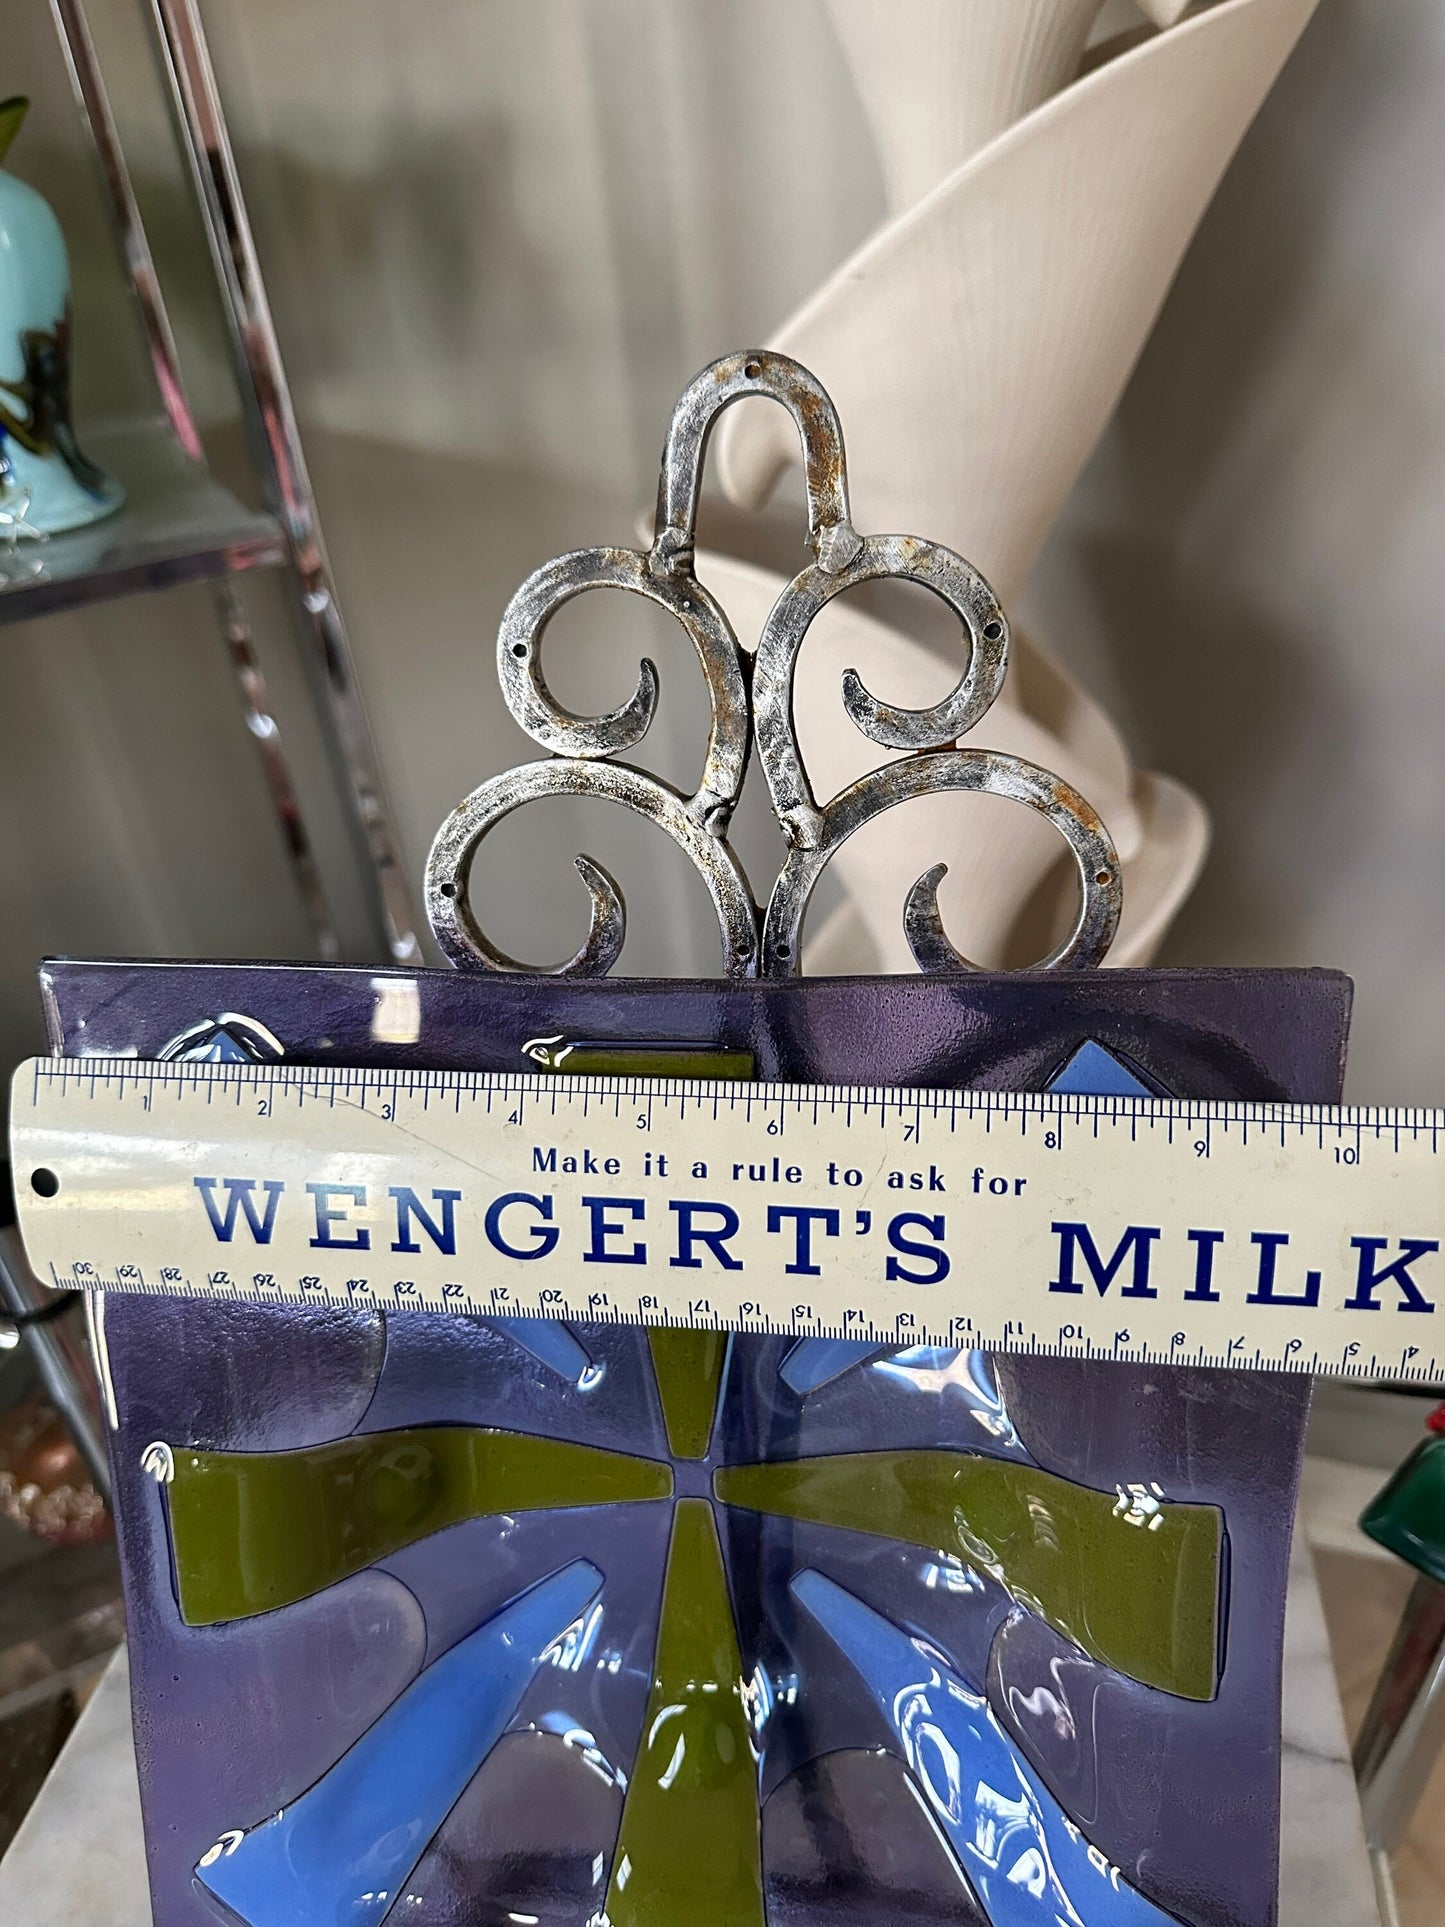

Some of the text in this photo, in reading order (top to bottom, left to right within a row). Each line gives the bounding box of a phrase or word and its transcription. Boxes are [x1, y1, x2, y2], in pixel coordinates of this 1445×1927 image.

[258, 1101, 268, 1116] 2
[381, 1104, 392, 1120] 3
[508, 1110, 518, 1125] 4
[636, 1114, 647, 1130] 5
[766, 1119, 779, 1136] 6
[903, 1125, 915, 1141] 7
[1044, 1131, 1056, 1149] 8
[1193, 1141, 1206, 1157] 9
[1334, 1147, 1356, 1165] 10
[532, 1147, 1028, 1196] Make it a rule to ask for
[193, 1176, 1440, 1313] WENGERT'S MILK
[76, 1262, 1419, 1358] 4 5 6 7 8 9 10 11 12 13 14 15 16 17 18 19 20 21 22 23 24 25 26 27 28 29 30
